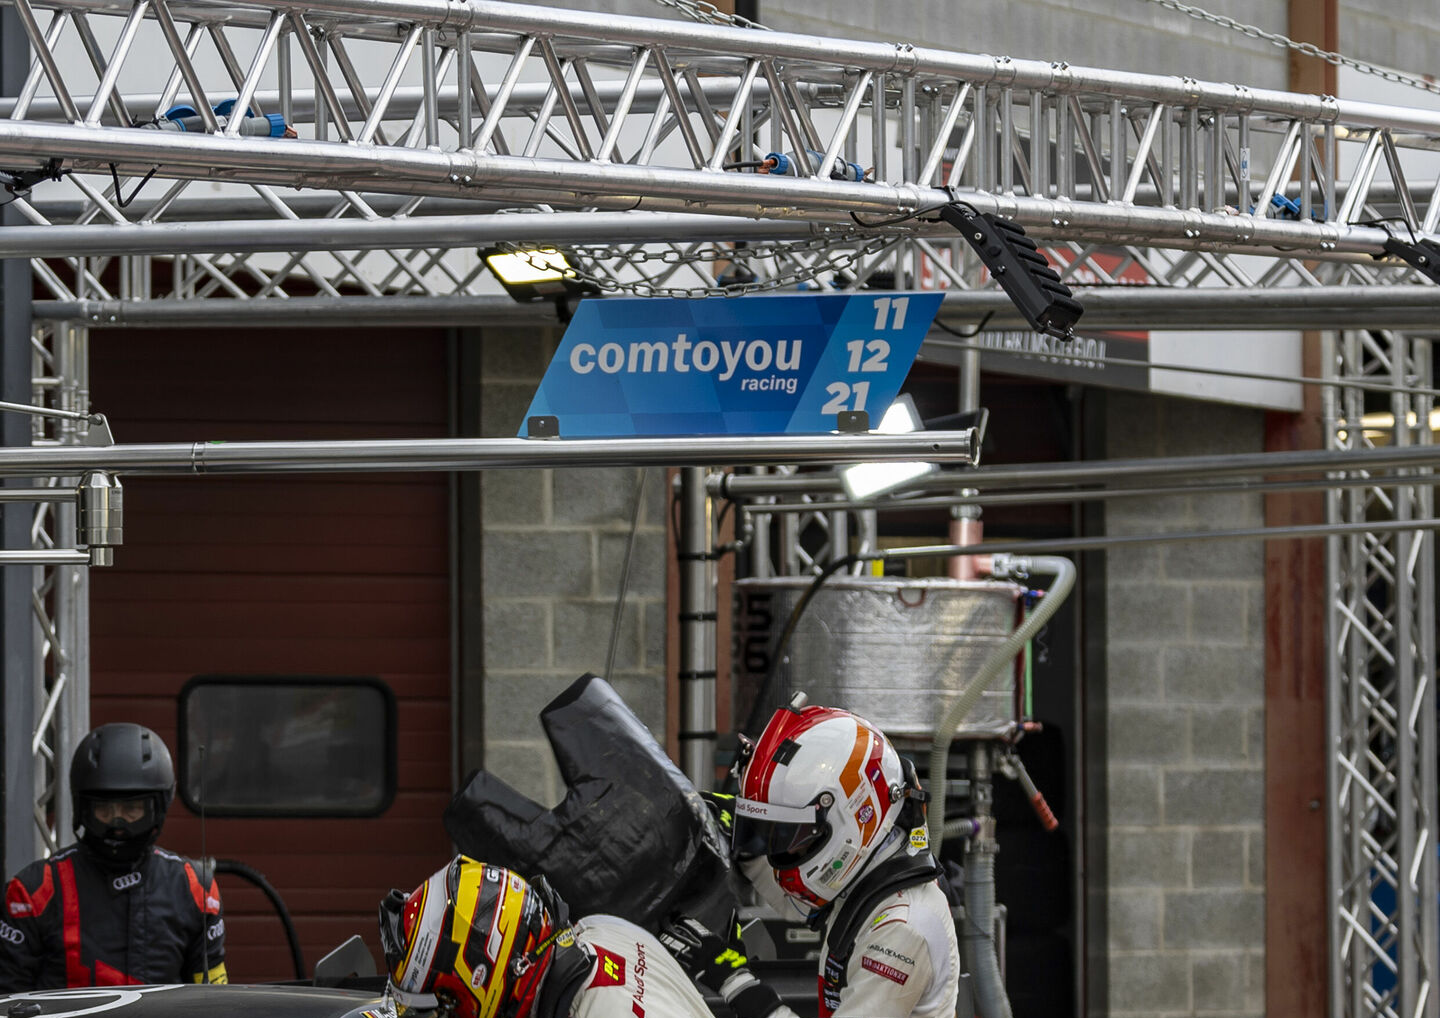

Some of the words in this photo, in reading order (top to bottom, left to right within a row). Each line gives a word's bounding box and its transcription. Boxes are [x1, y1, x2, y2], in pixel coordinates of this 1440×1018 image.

[873, 297, 910, 330] 11
[569, 333, 803, 381] comtoyou
[846, 339, 891, 372] 12
[741, 374, 799, 394] racing
[821, 381, 871, 415] 21
[747, 804, 768, 815] Sport
[634, 942, 648, 977] Sport
